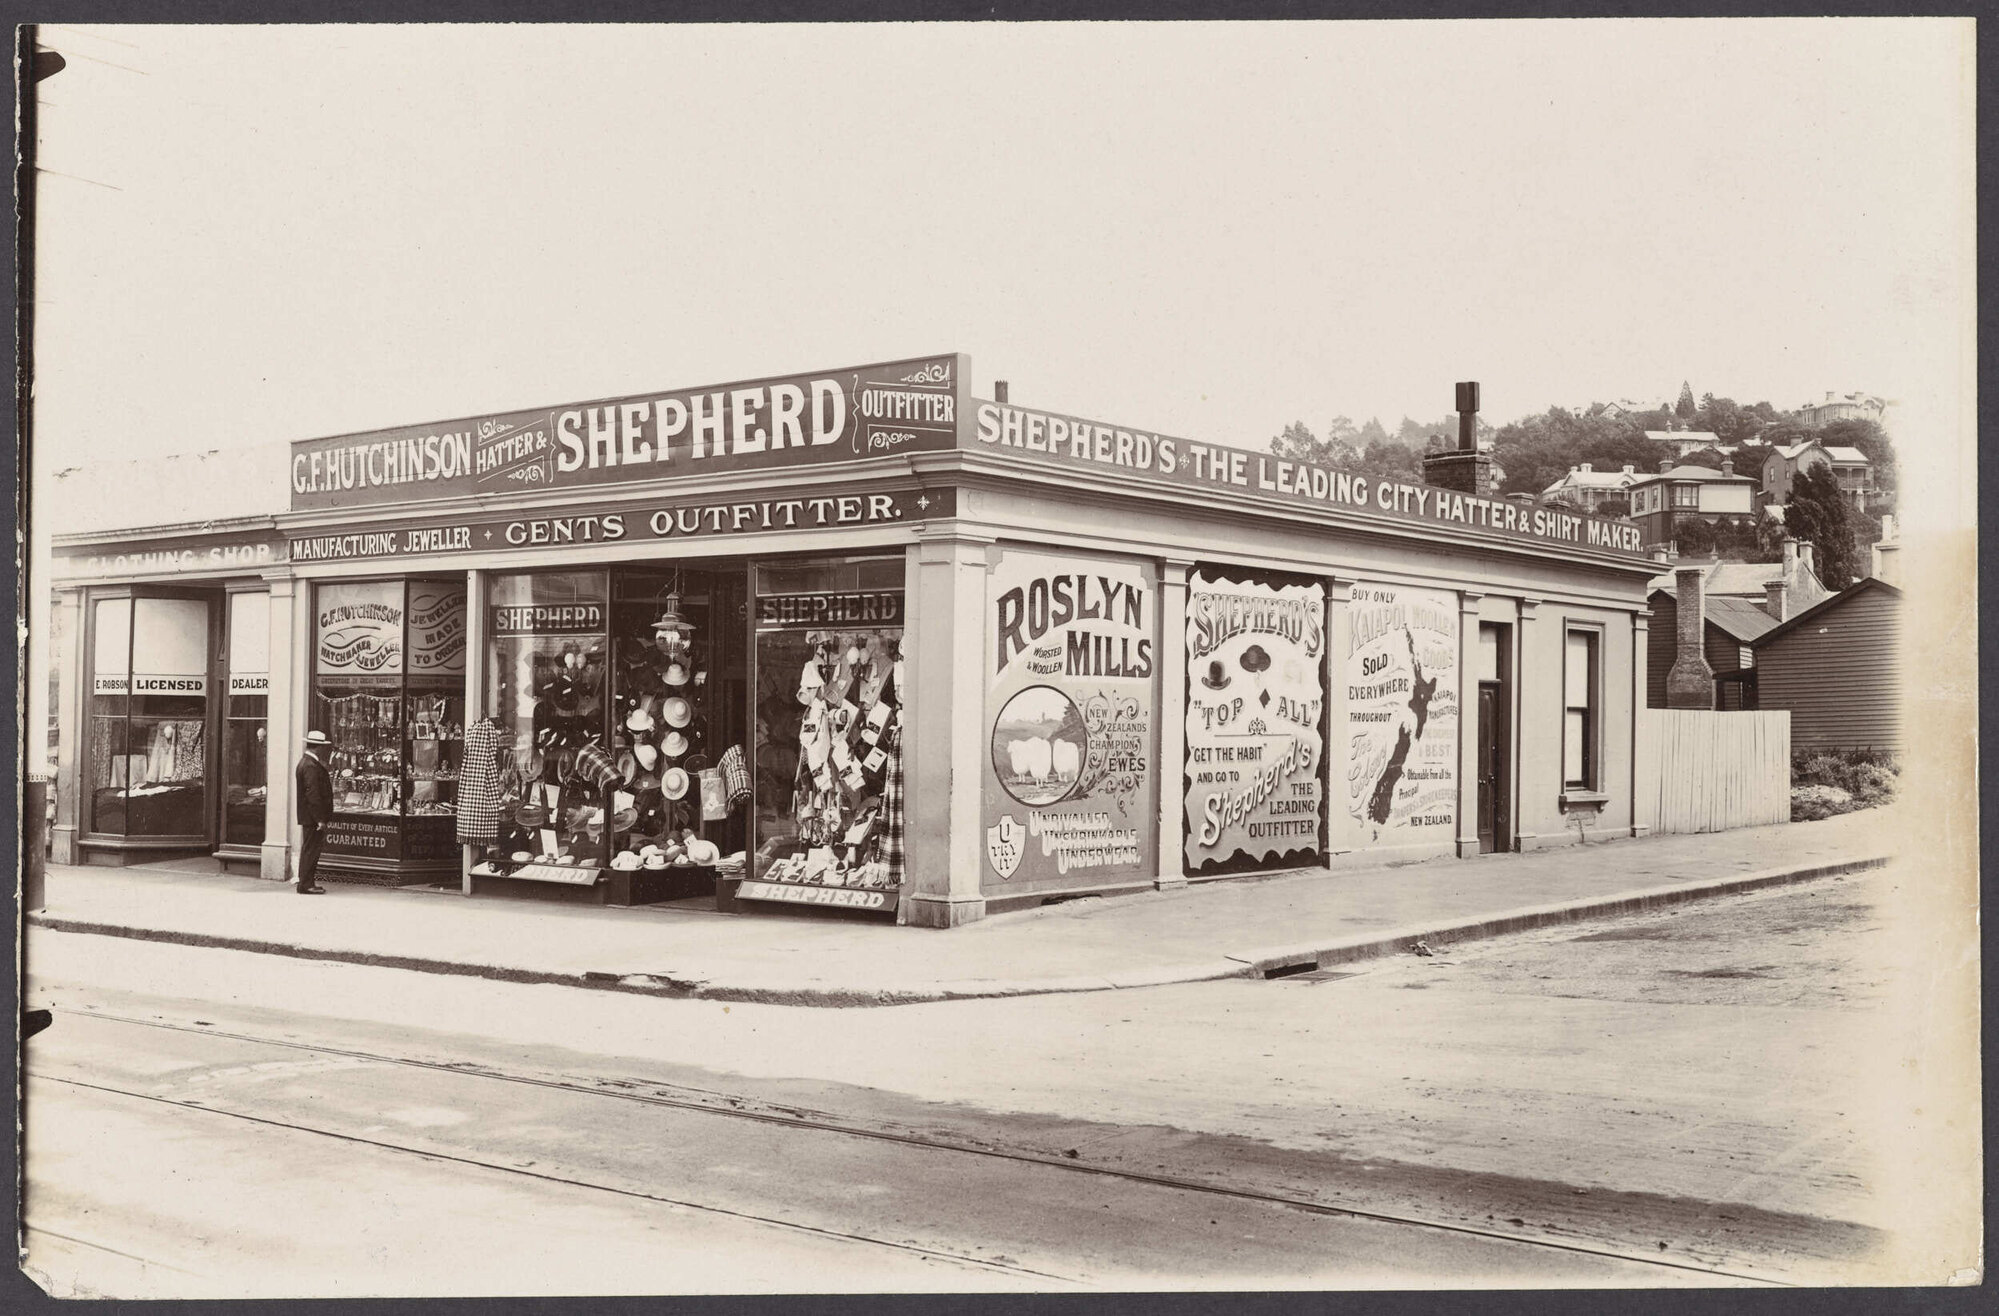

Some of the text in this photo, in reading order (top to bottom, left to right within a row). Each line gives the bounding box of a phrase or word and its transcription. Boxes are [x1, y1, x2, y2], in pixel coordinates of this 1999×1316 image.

[861, 388, 955, 423] OUTFITTER
[557, 379, 847, 473] SHEPHERD
[476, 430, 548, 475] HATTER &
[977, 404, 1644, 552] SHEPHERD'S THE LEADING CITY HATTER & SHIRT MAKER.
[505, 494, 903, 547] GENTS OUTFITTER.
[209, 543, 270, 564] SHOP
[293, 527, 472, 561] MANUFACTURING JEWELLER
[1352, 588, 1397, 604] BUY ONLY
[496, 605, 601, 631] SHEPHERD
[763, 594, 897, 623] SHEPHERD
[425, 617, 462, 646] MADE
[996, 574, 1144, 676] ROSLYN
[1193, 592, 1321, 660] SHEPHERD'S
[1347, 605, 1406, 661] KAIAPOI
[321, 640, 372, 662] WATCHMAKER
[414, 653, 431, 664] TO
[1034, 646, 1062, 659] WORSTED
[1065, 631, 1152, 679] MILLS
[1032, 661, 1063, 675] WOOLLEN
[1362, 653, 1388, 676] SOLD
[136, 679, 203, 691] LICENSED
[232, 678, 268, 690] DEALER
[1349, 678, 1409, 701] EVERYWHERE
[1089, 709, 1108, 718] NEW
[1350, 711, 1392, 722] THROUGHOUT
[1107, 723, 1147, 733] ZEALANDS
[1089, 740, 1135, 750] CHAMPION
[1215, 747, 1234, 761] THE
[1108, 757, 1146, 772] EWES
[1197, 771, 1239, 783] AND GO TO
[1198, 737, 1312, 847] Shepherd's
[1290, 783, 1314, 796] THE
[1269, 800, 1315, 815] LEADING
[327, 821, 350, 831] QUALITY
[350, 823, 357, 831] OF
[358, 823, 374, 832] EVERY
[374, 824, 398, 834] ARTICLE
[1248, 820, 1314, 838] OUTFITTER
[1410, 817, 1422, 827] NEW
[326, 834, 386, 848] GUARANTEED
[999, 823, 1010, 844] U
[751, 881, 885, 909] SHEPHERD
